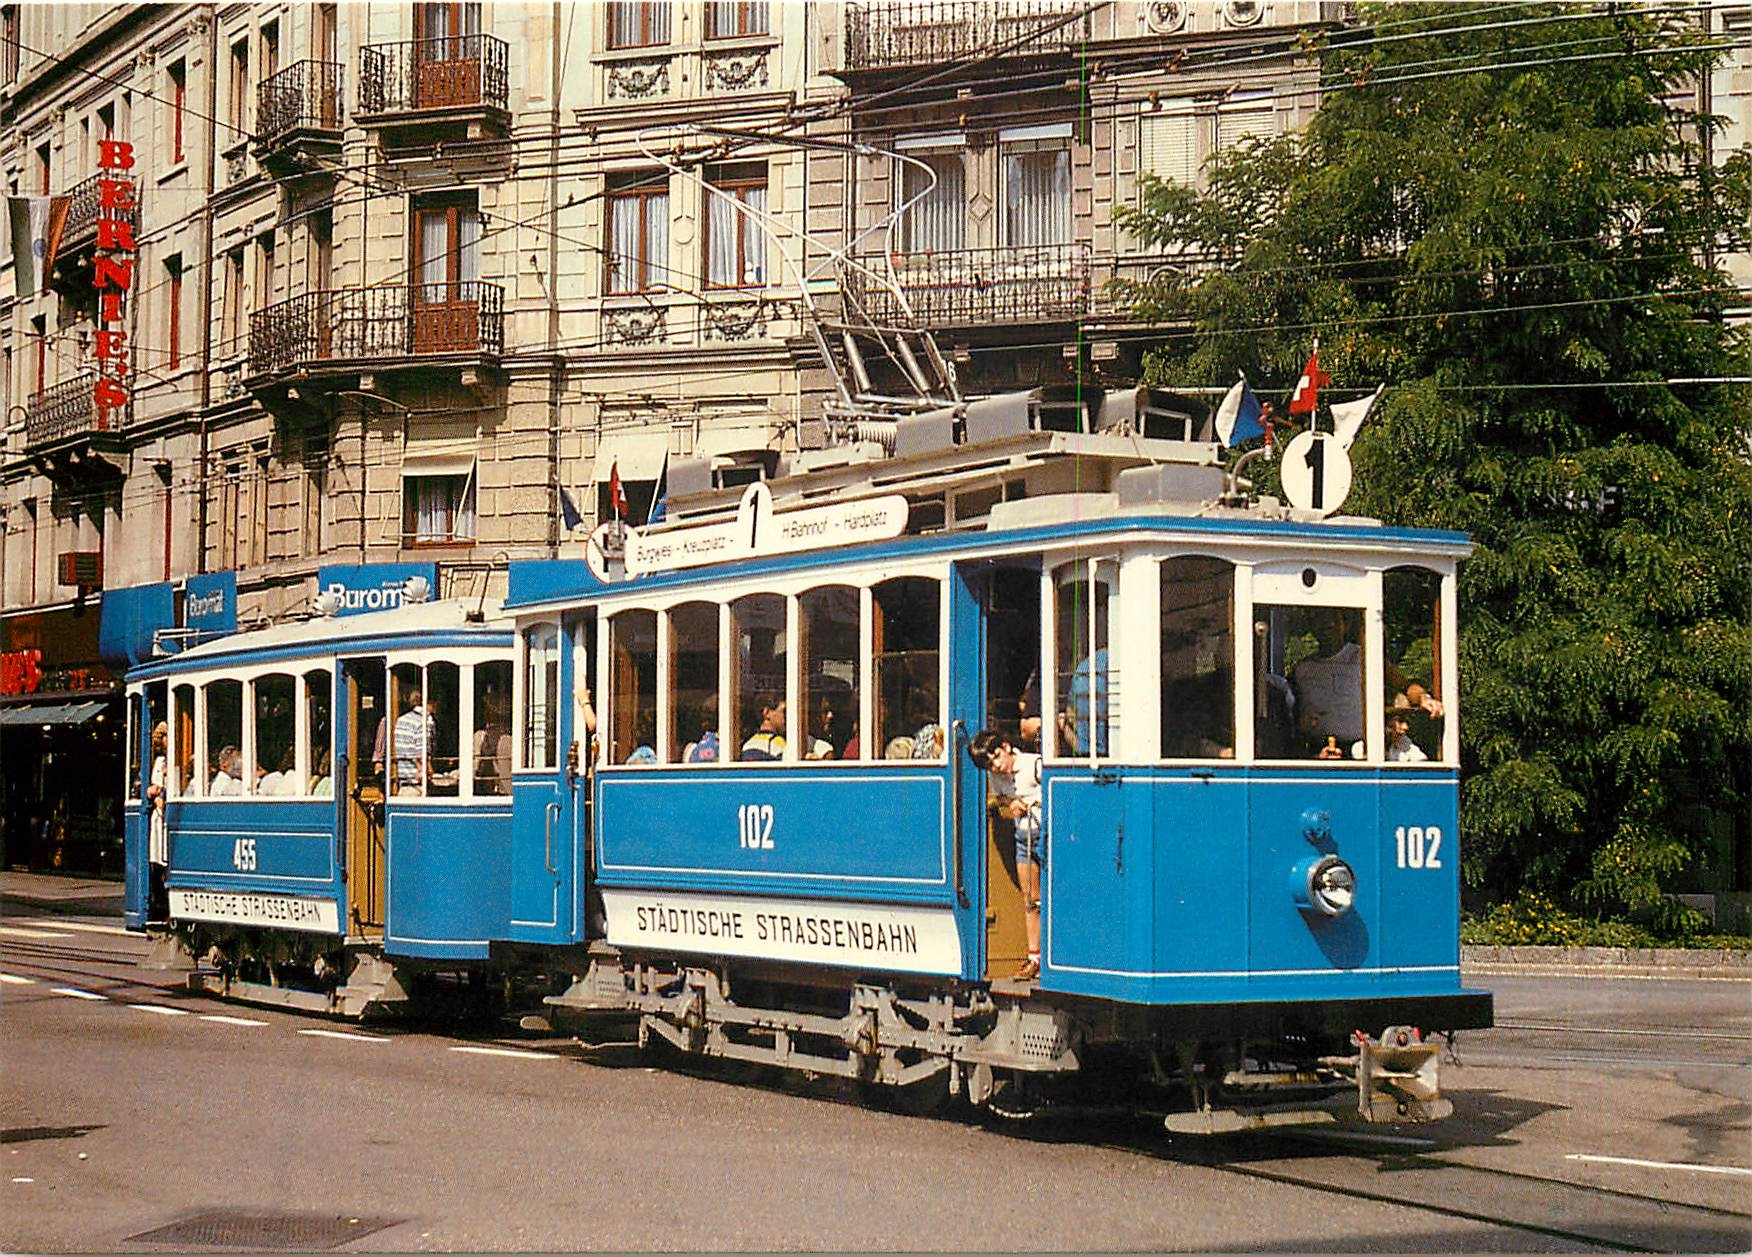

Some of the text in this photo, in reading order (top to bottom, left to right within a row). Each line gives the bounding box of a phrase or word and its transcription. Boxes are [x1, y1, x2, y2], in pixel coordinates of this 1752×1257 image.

[92, 140, 138, 408] BERNIE'S
[1304, 438, 1325, 509] 1
[749, 490, 759, 549] 1
[843, 510, 888, 531] Hardplatz
[737, 804, 775, 850] 102
[1395, 826, 1442, 869] 102
[233, 838, 257, 871] 455
[242, 896, 322, 923] STRASSENBAHN
[637, 902, 919, 954] STÄDTISCHE STRASSENBAHN
